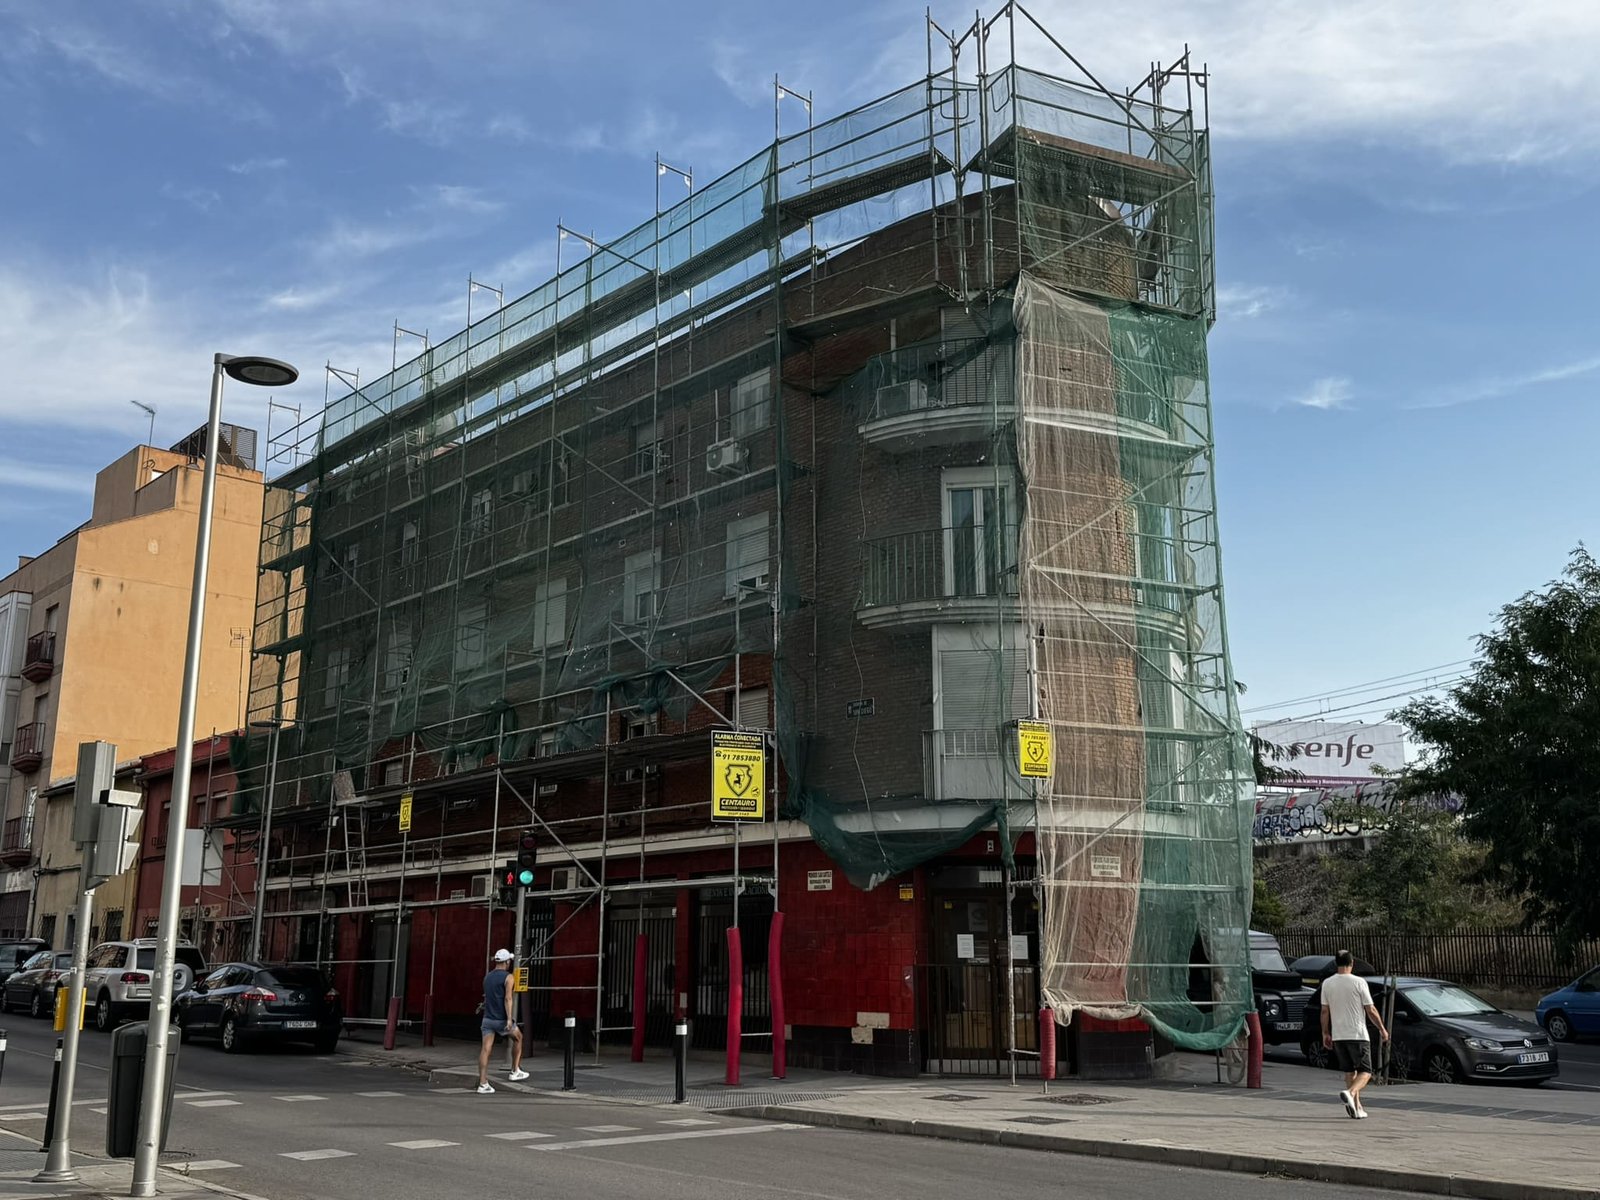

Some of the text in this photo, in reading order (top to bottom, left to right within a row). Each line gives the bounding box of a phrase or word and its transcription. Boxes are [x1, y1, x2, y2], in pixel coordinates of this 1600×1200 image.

[714, 733, 761, 742] ALARMA CONECTADA
[721, 799, 756, 807] CENTAURO
